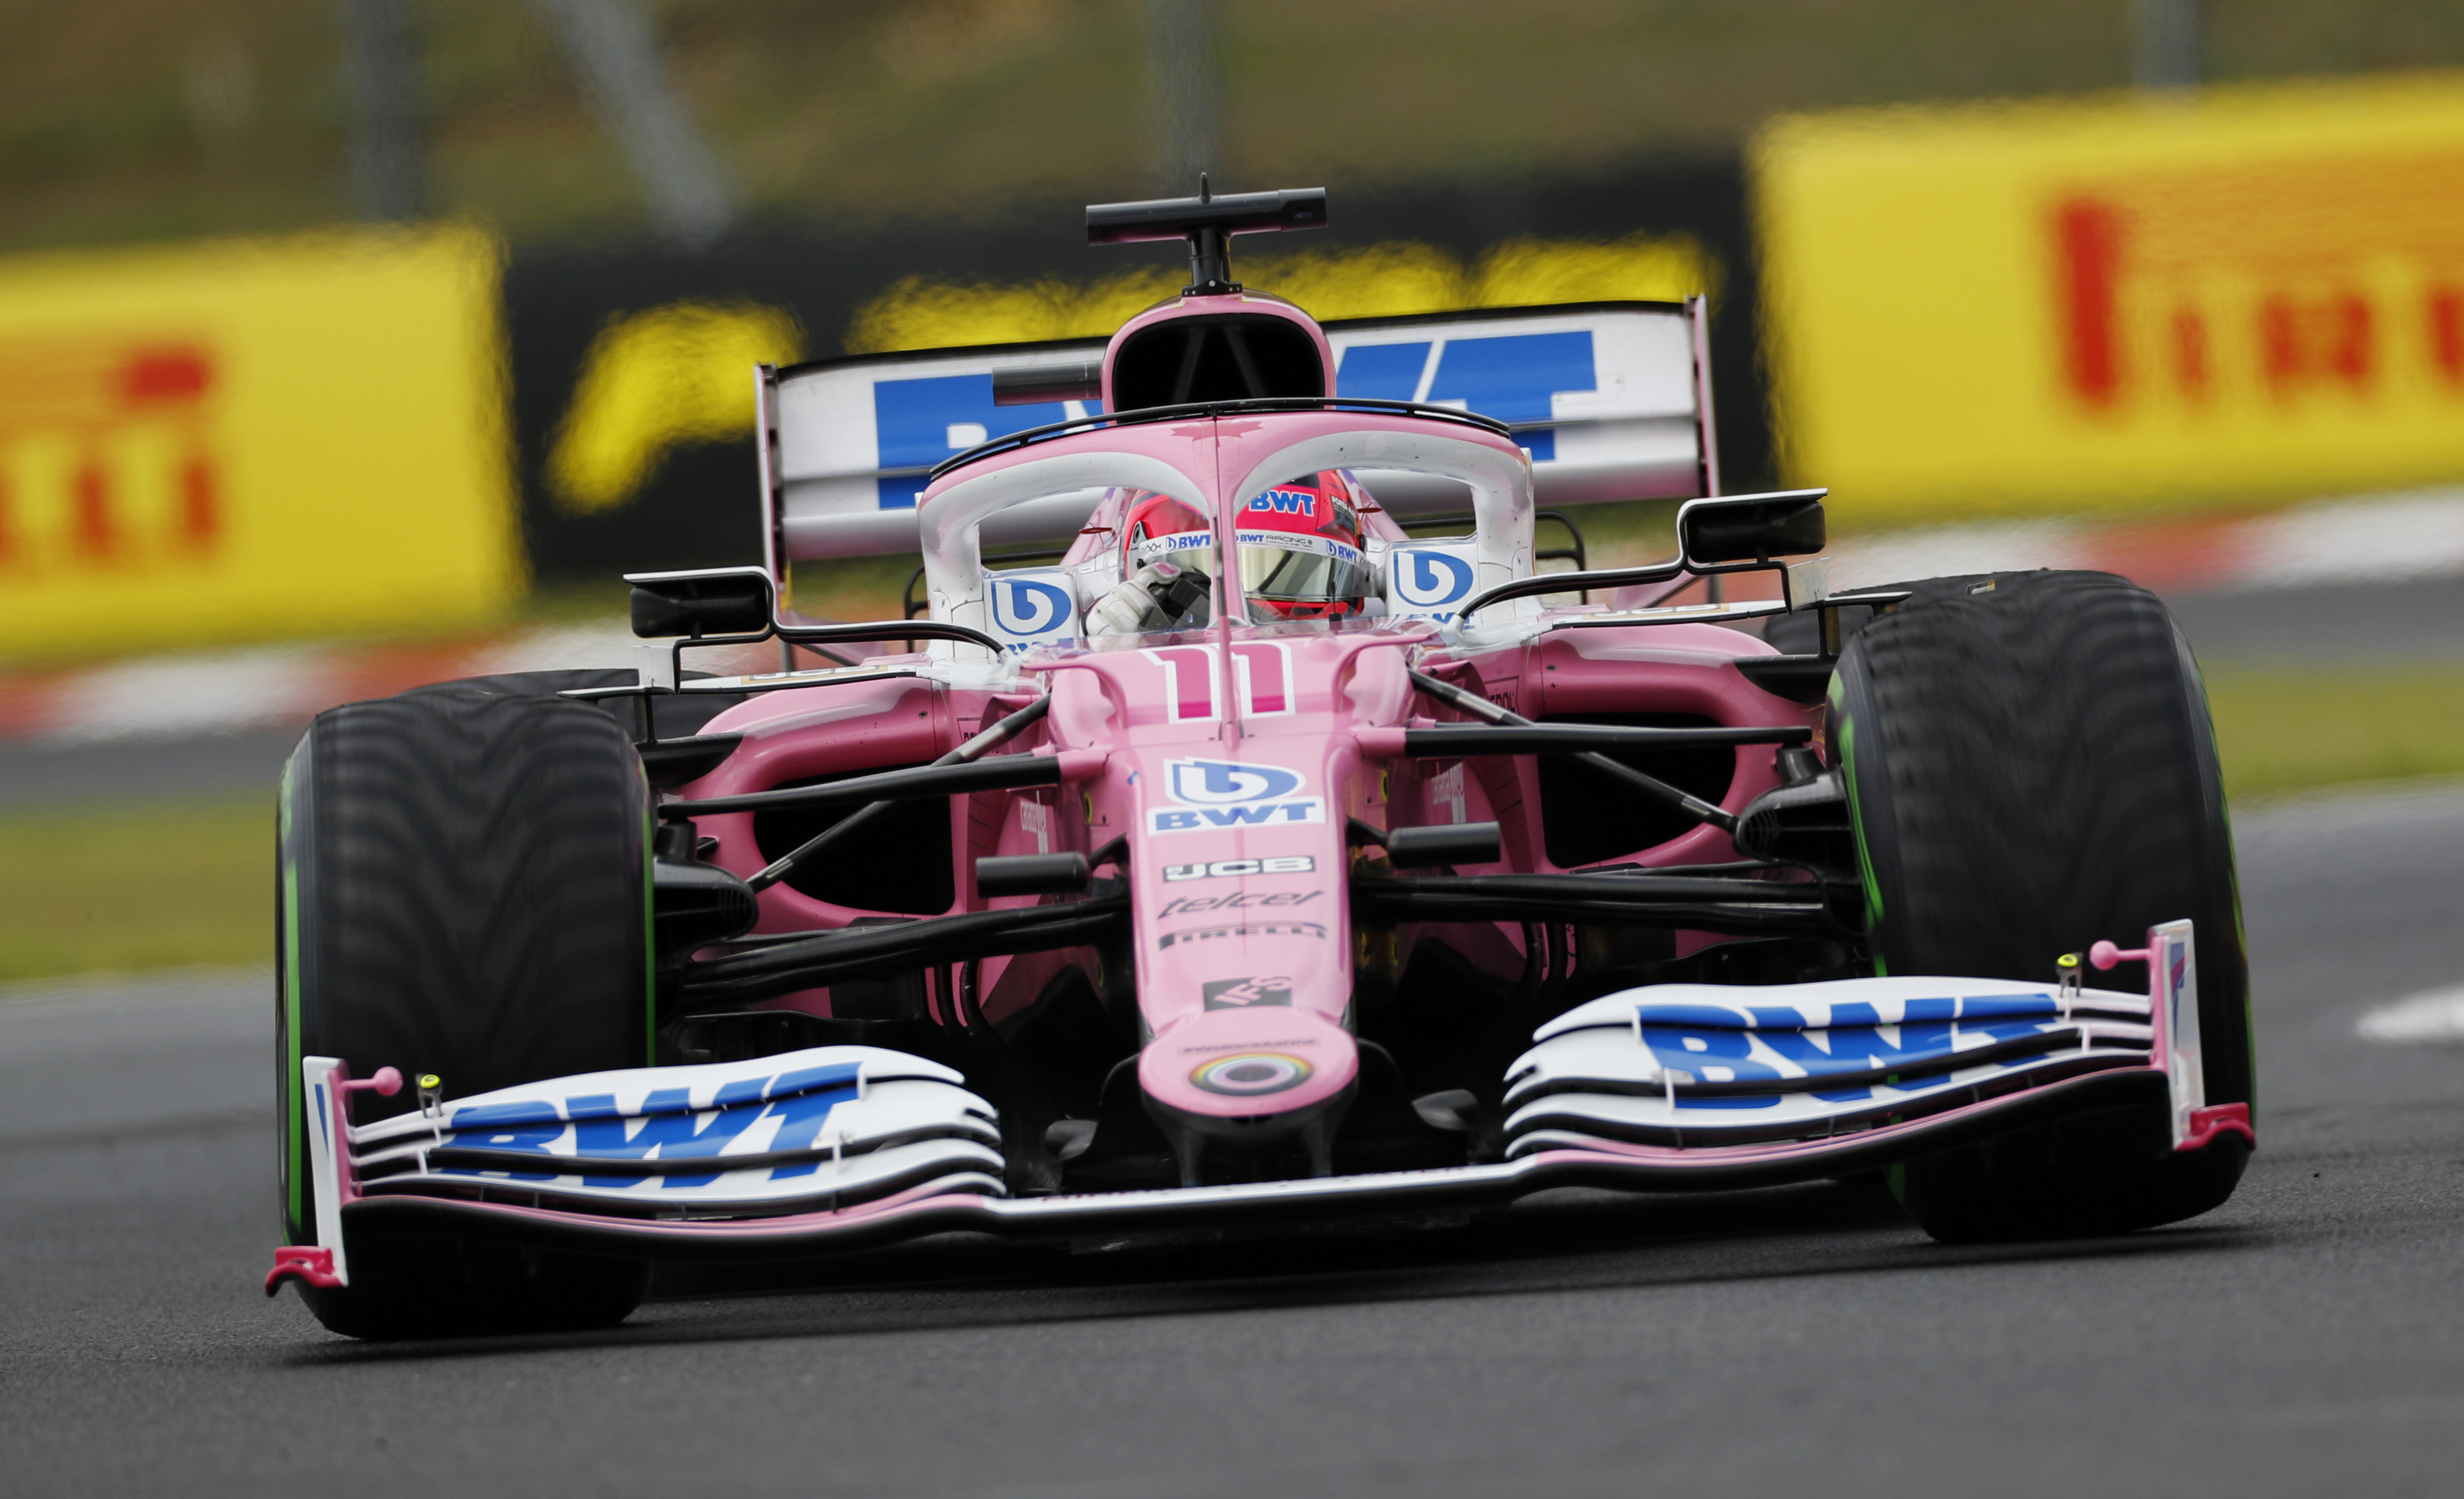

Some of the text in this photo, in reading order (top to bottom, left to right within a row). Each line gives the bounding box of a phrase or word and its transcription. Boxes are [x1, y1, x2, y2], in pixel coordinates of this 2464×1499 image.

[1249, 490, 1316, 517] BWT
[1241, 534, 1306, 544] BWT RACING
[1338, 545, 1357, 563] BWT
[1139, 641, 1296, 724] 11
[1156, 801, 1317, 832] BWT
[1166, 856, 1313, 881] JCB
[1157, 890, 1324, 920] telcel
[436, 1061, 864, 1188] BWT
